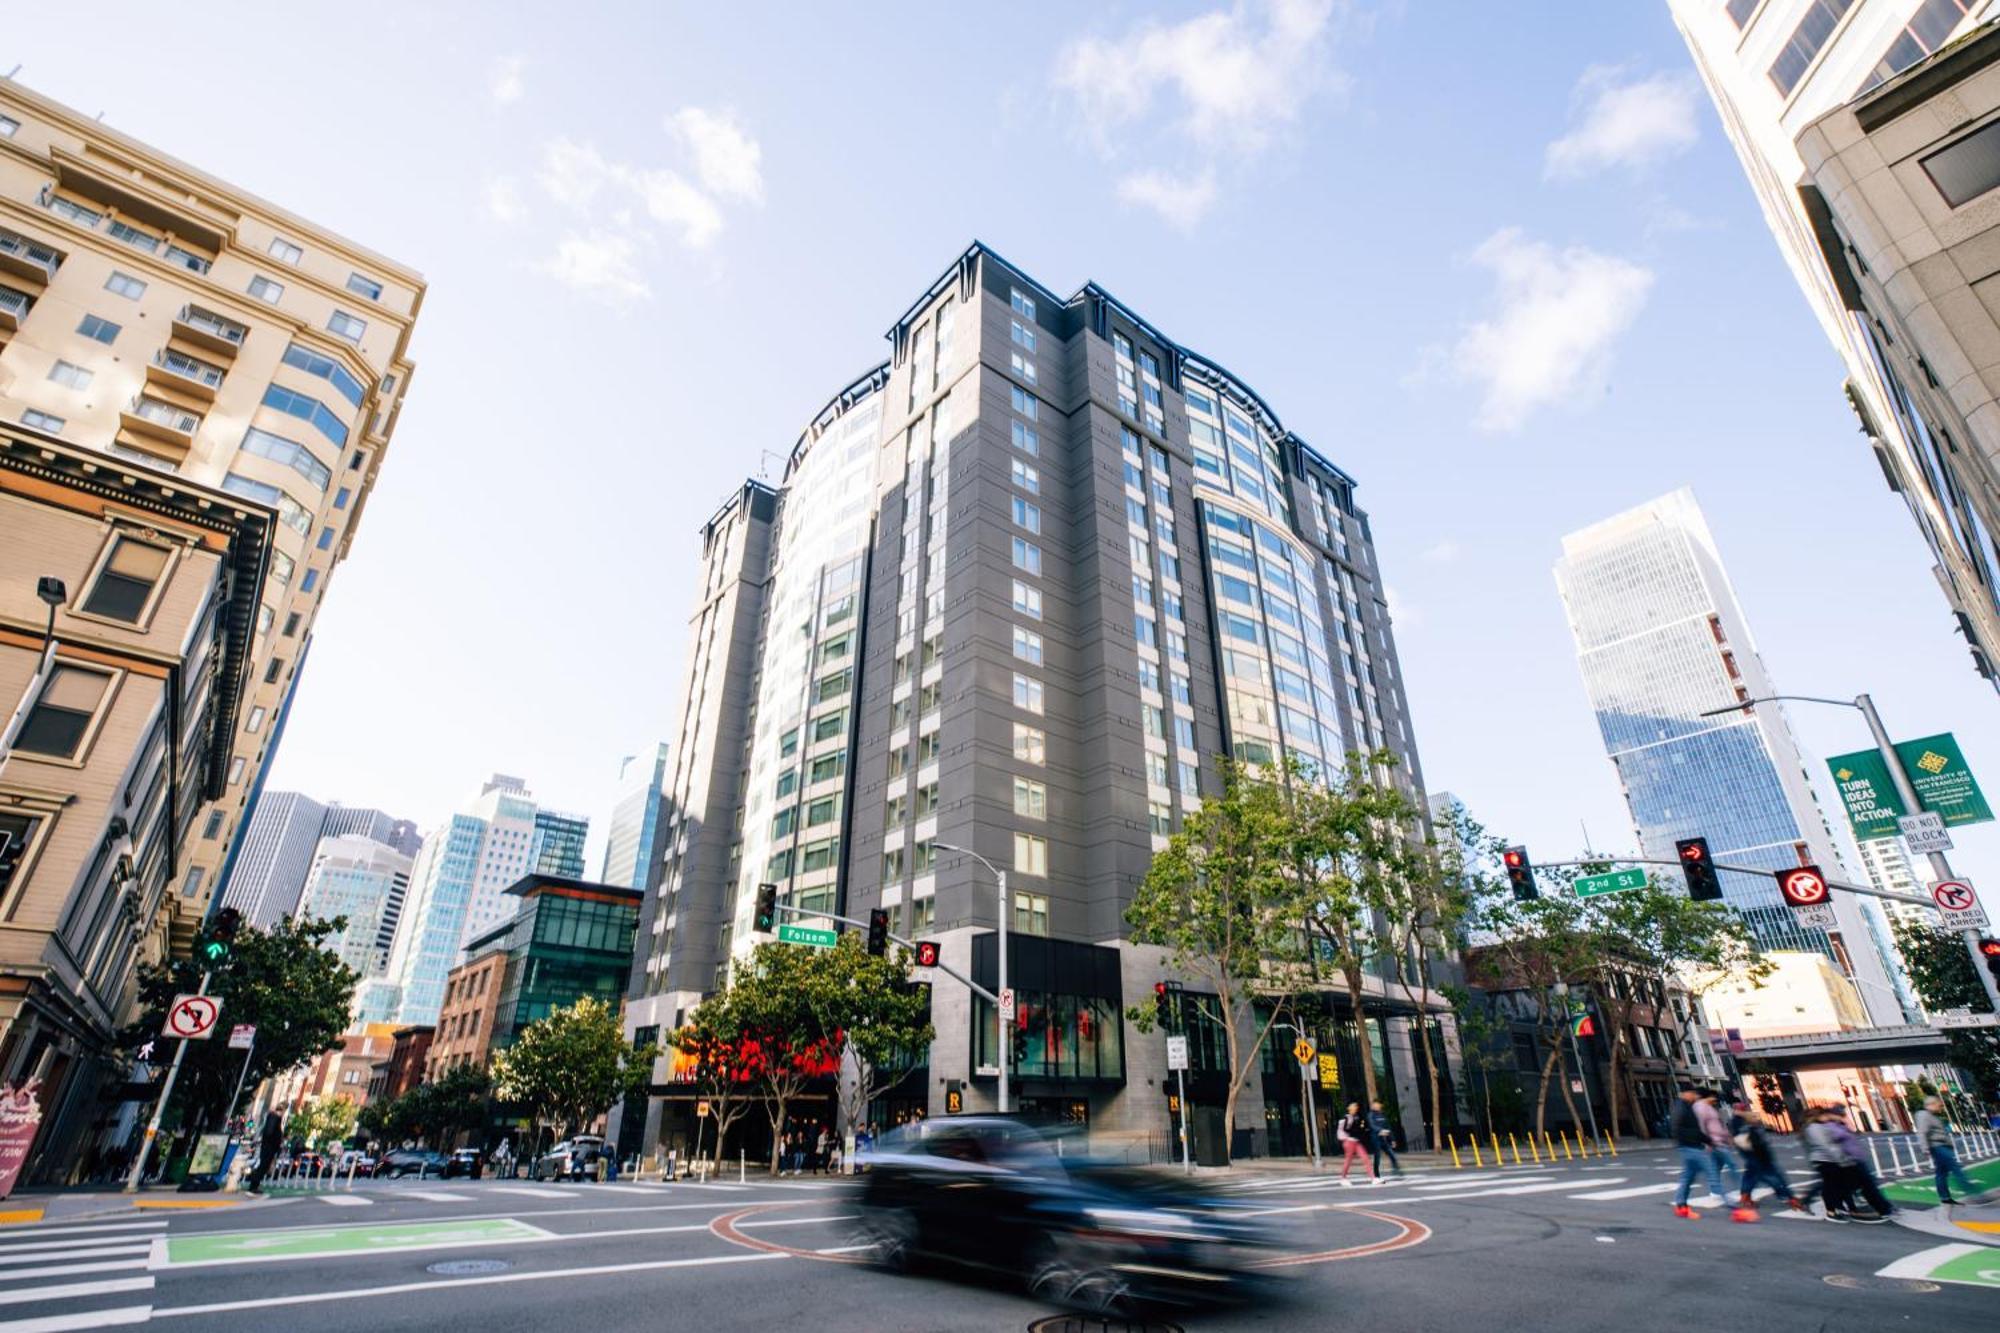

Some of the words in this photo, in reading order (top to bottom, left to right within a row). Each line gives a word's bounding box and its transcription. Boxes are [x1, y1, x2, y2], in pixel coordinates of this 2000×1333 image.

[1841, 779, 1871, 792] TURN
[1913, 773, 1954, 785] UNIVERSITY
[1845, 789, 1877, 802] IDEAS
[1849, 800, 1875, 813] INTO
[1855, 808, 1896, 822] ACTION.
[1902, 820, 1915, 831] DO
[1919, 816, 1939, 827] NOT
[1908, 828, 1945, 843] BLOCK
[1587, 879, 1609, 892] 2nd
[1618, 875, 1634, 886] St
[1797, 904, 1828, 914] EXCEPT
[1945, 912, 1960, 920] ON
[1962, 909, 1982, 918] RED
[1950, 917, 1984, 927] ARROW
[788, 930, 828, 943] Folsom
[950, 1092, 960, 1108] R
